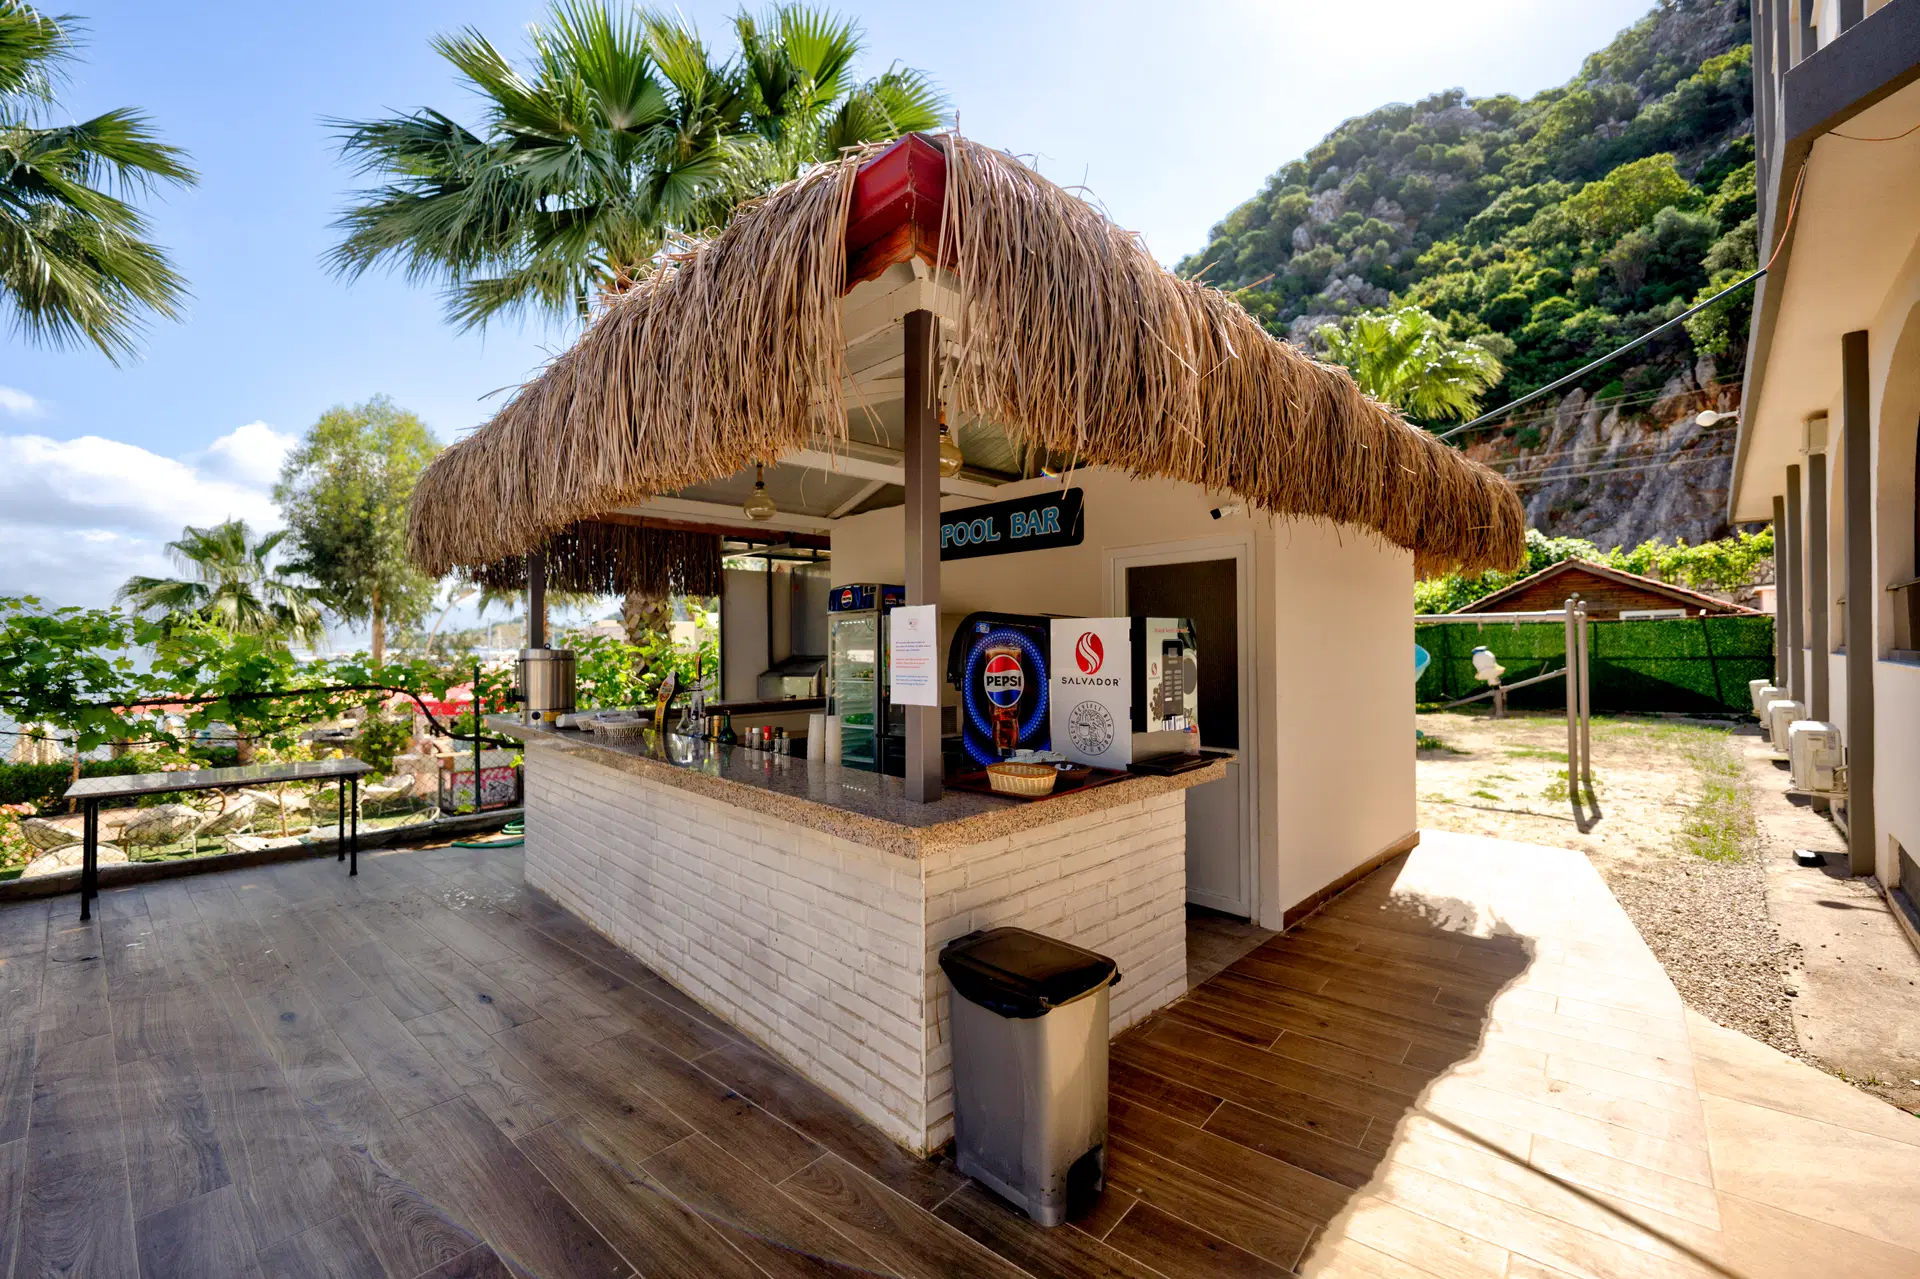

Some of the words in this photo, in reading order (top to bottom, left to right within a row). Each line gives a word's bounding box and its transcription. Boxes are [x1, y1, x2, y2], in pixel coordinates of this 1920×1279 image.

[940, 517, 1001, 548] POOL
[1010, 506, 1061, 539] BAR
[986, 675, 1022, 687] PEPSI
[1061, 676, 1120, 686] SALVADOR
